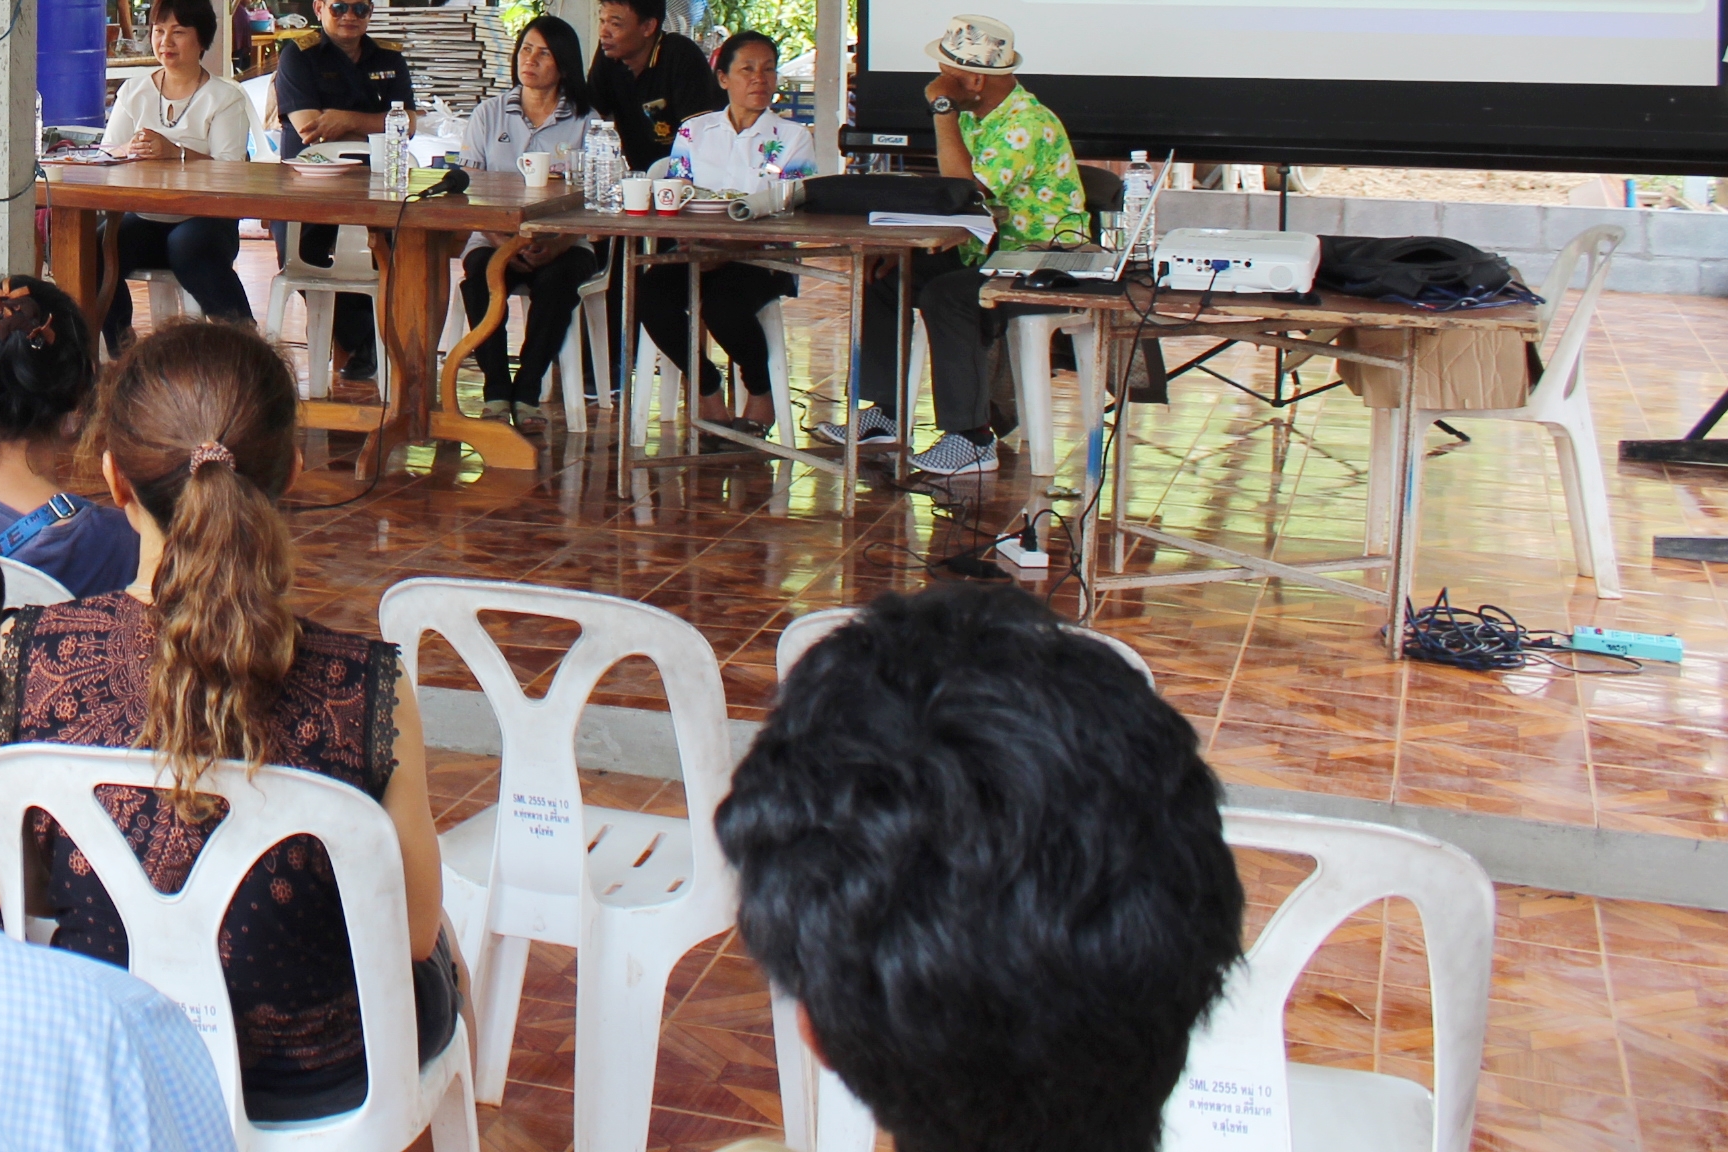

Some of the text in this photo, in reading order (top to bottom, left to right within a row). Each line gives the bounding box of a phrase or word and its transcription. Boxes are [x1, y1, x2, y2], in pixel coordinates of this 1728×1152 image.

[513, 793, 526, 804] SML
[529, 795, 546, 806] 2555
[559, 800, 569, 809] 10
[204, 1005, 216, 1016] 10
[1188, 1078, 1209, 1092] SML
[1212, 1080, 1238, 1094] 2555
[1258, 1085, 1272, 1097] 10
